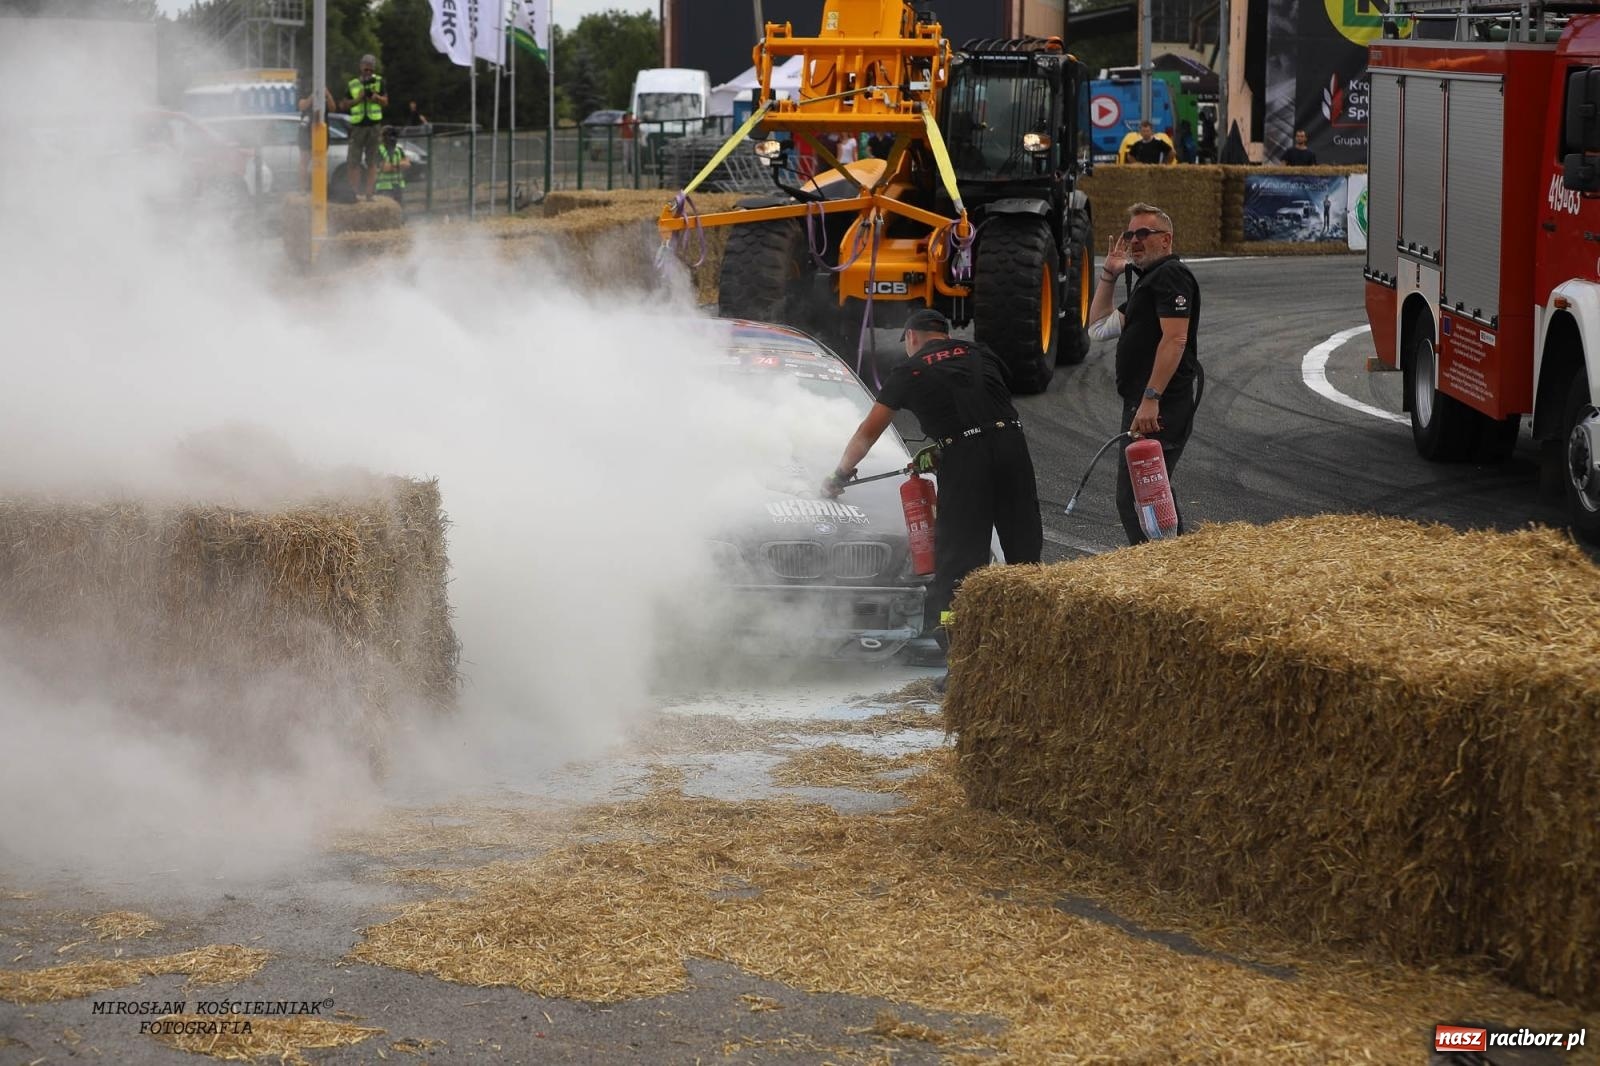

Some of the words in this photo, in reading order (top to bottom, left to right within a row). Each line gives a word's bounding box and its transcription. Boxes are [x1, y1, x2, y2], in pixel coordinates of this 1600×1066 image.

[1333, 135, 1361, 147] Grupa
[865, 282, 907, 294] JCB
[830, 516, 871, 526] TEAM
